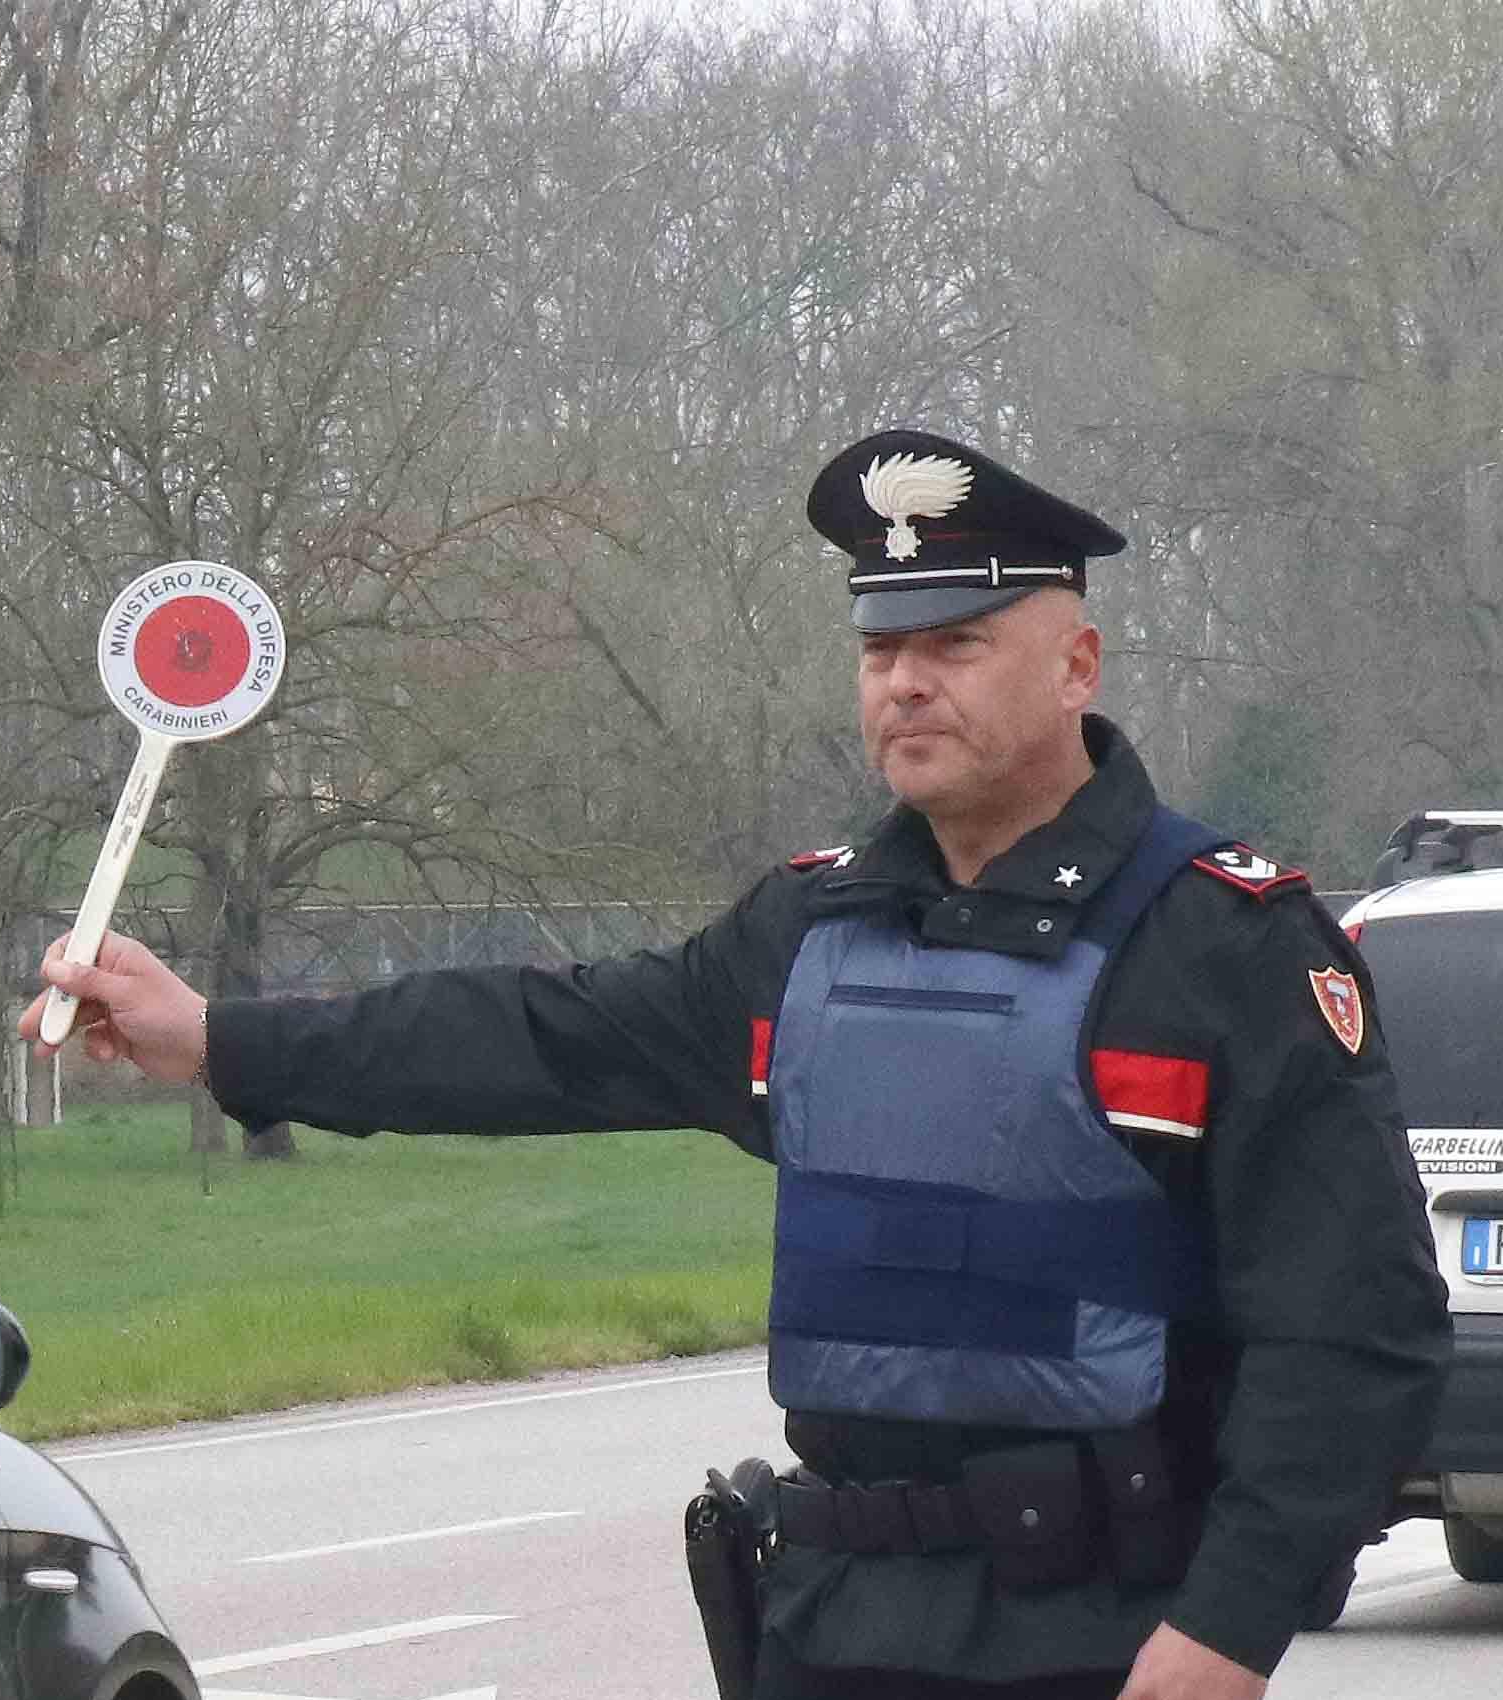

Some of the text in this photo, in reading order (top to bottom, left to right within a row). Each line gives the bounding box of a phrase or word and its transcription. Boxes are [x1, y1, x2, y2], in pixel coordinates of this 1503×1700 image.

[110, 572, 276, 693] MINISTERO DELLA DIFESA
[124, 687, 229, 729] CARABINIERI
[1417, 1162, 1497, 1173] EVISIONI
